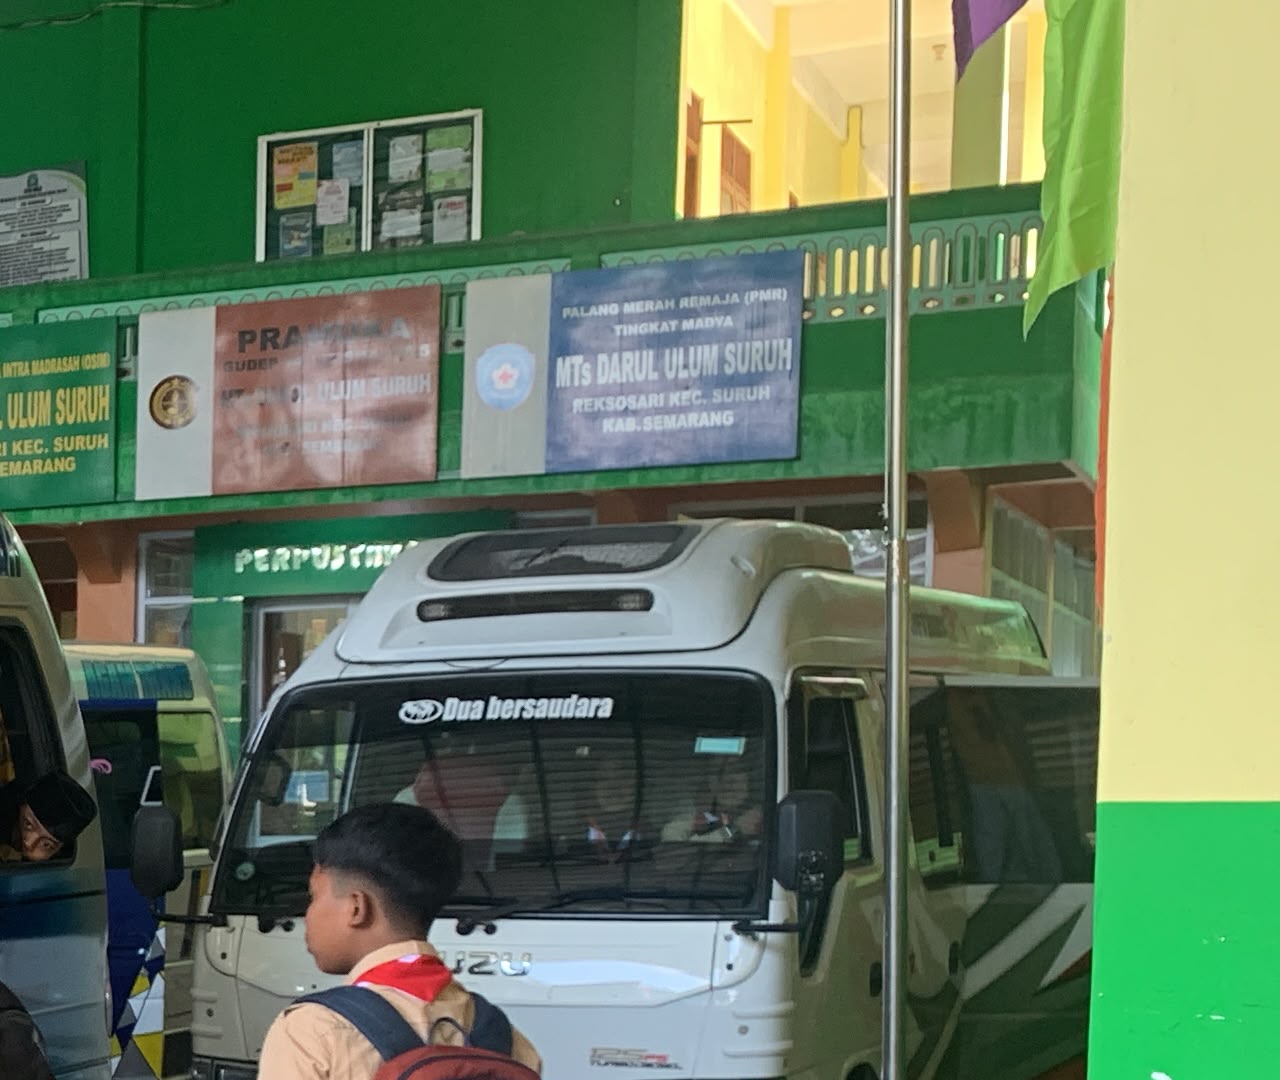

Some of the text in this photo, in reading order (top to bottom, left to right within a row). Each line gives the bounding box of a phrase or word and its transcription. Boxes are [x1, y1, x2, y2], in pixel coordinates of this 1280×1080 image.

[562, 288, 788, 319] PALANG MERAH REMAJA (PMR)
[614, 316, 733, 336] TINGKAT MADYA
[556, 338, 792, 388] MTs DARUL ULUM SURUH
[7, 389, 51, 429] ULUM
[55, 384, 110, 425] SURUH
[573, 385, 770, 414] REKSOSARI KEC. SURUH
[643, 411, 734, 430] SEMARANG
[12, 439, 48, 456] KEC.
[53, 433, 109, 452] SURUH
[442, 694, 615, 722] Dua bersaudara
